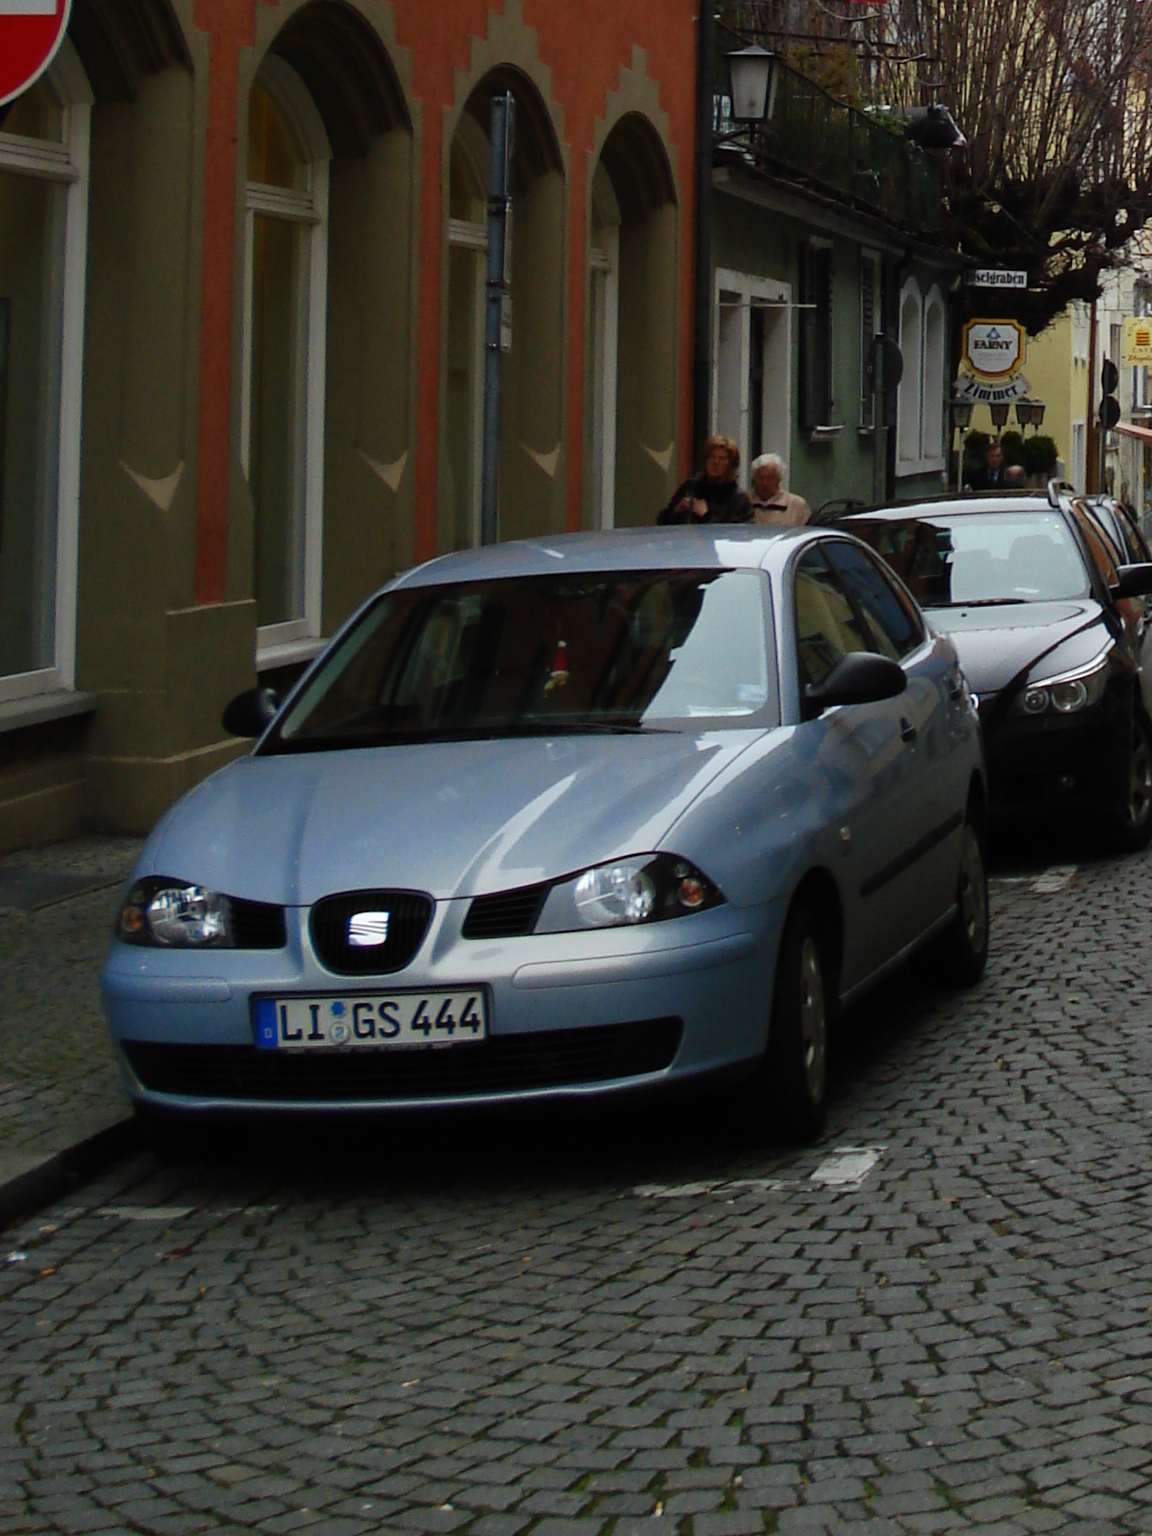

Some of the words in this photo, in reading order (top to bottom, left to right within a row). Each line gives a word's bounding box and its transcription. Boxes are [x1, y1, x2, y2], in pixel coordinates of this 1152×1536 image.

[973, 340, 1013, 349] FARNY
[964, 383, 1018, 401] Zimmer
[280, 1004, 325, 1041] LI
[353, 1001, 401, 1039] GS
[411, 997, 481, 1036] 444
